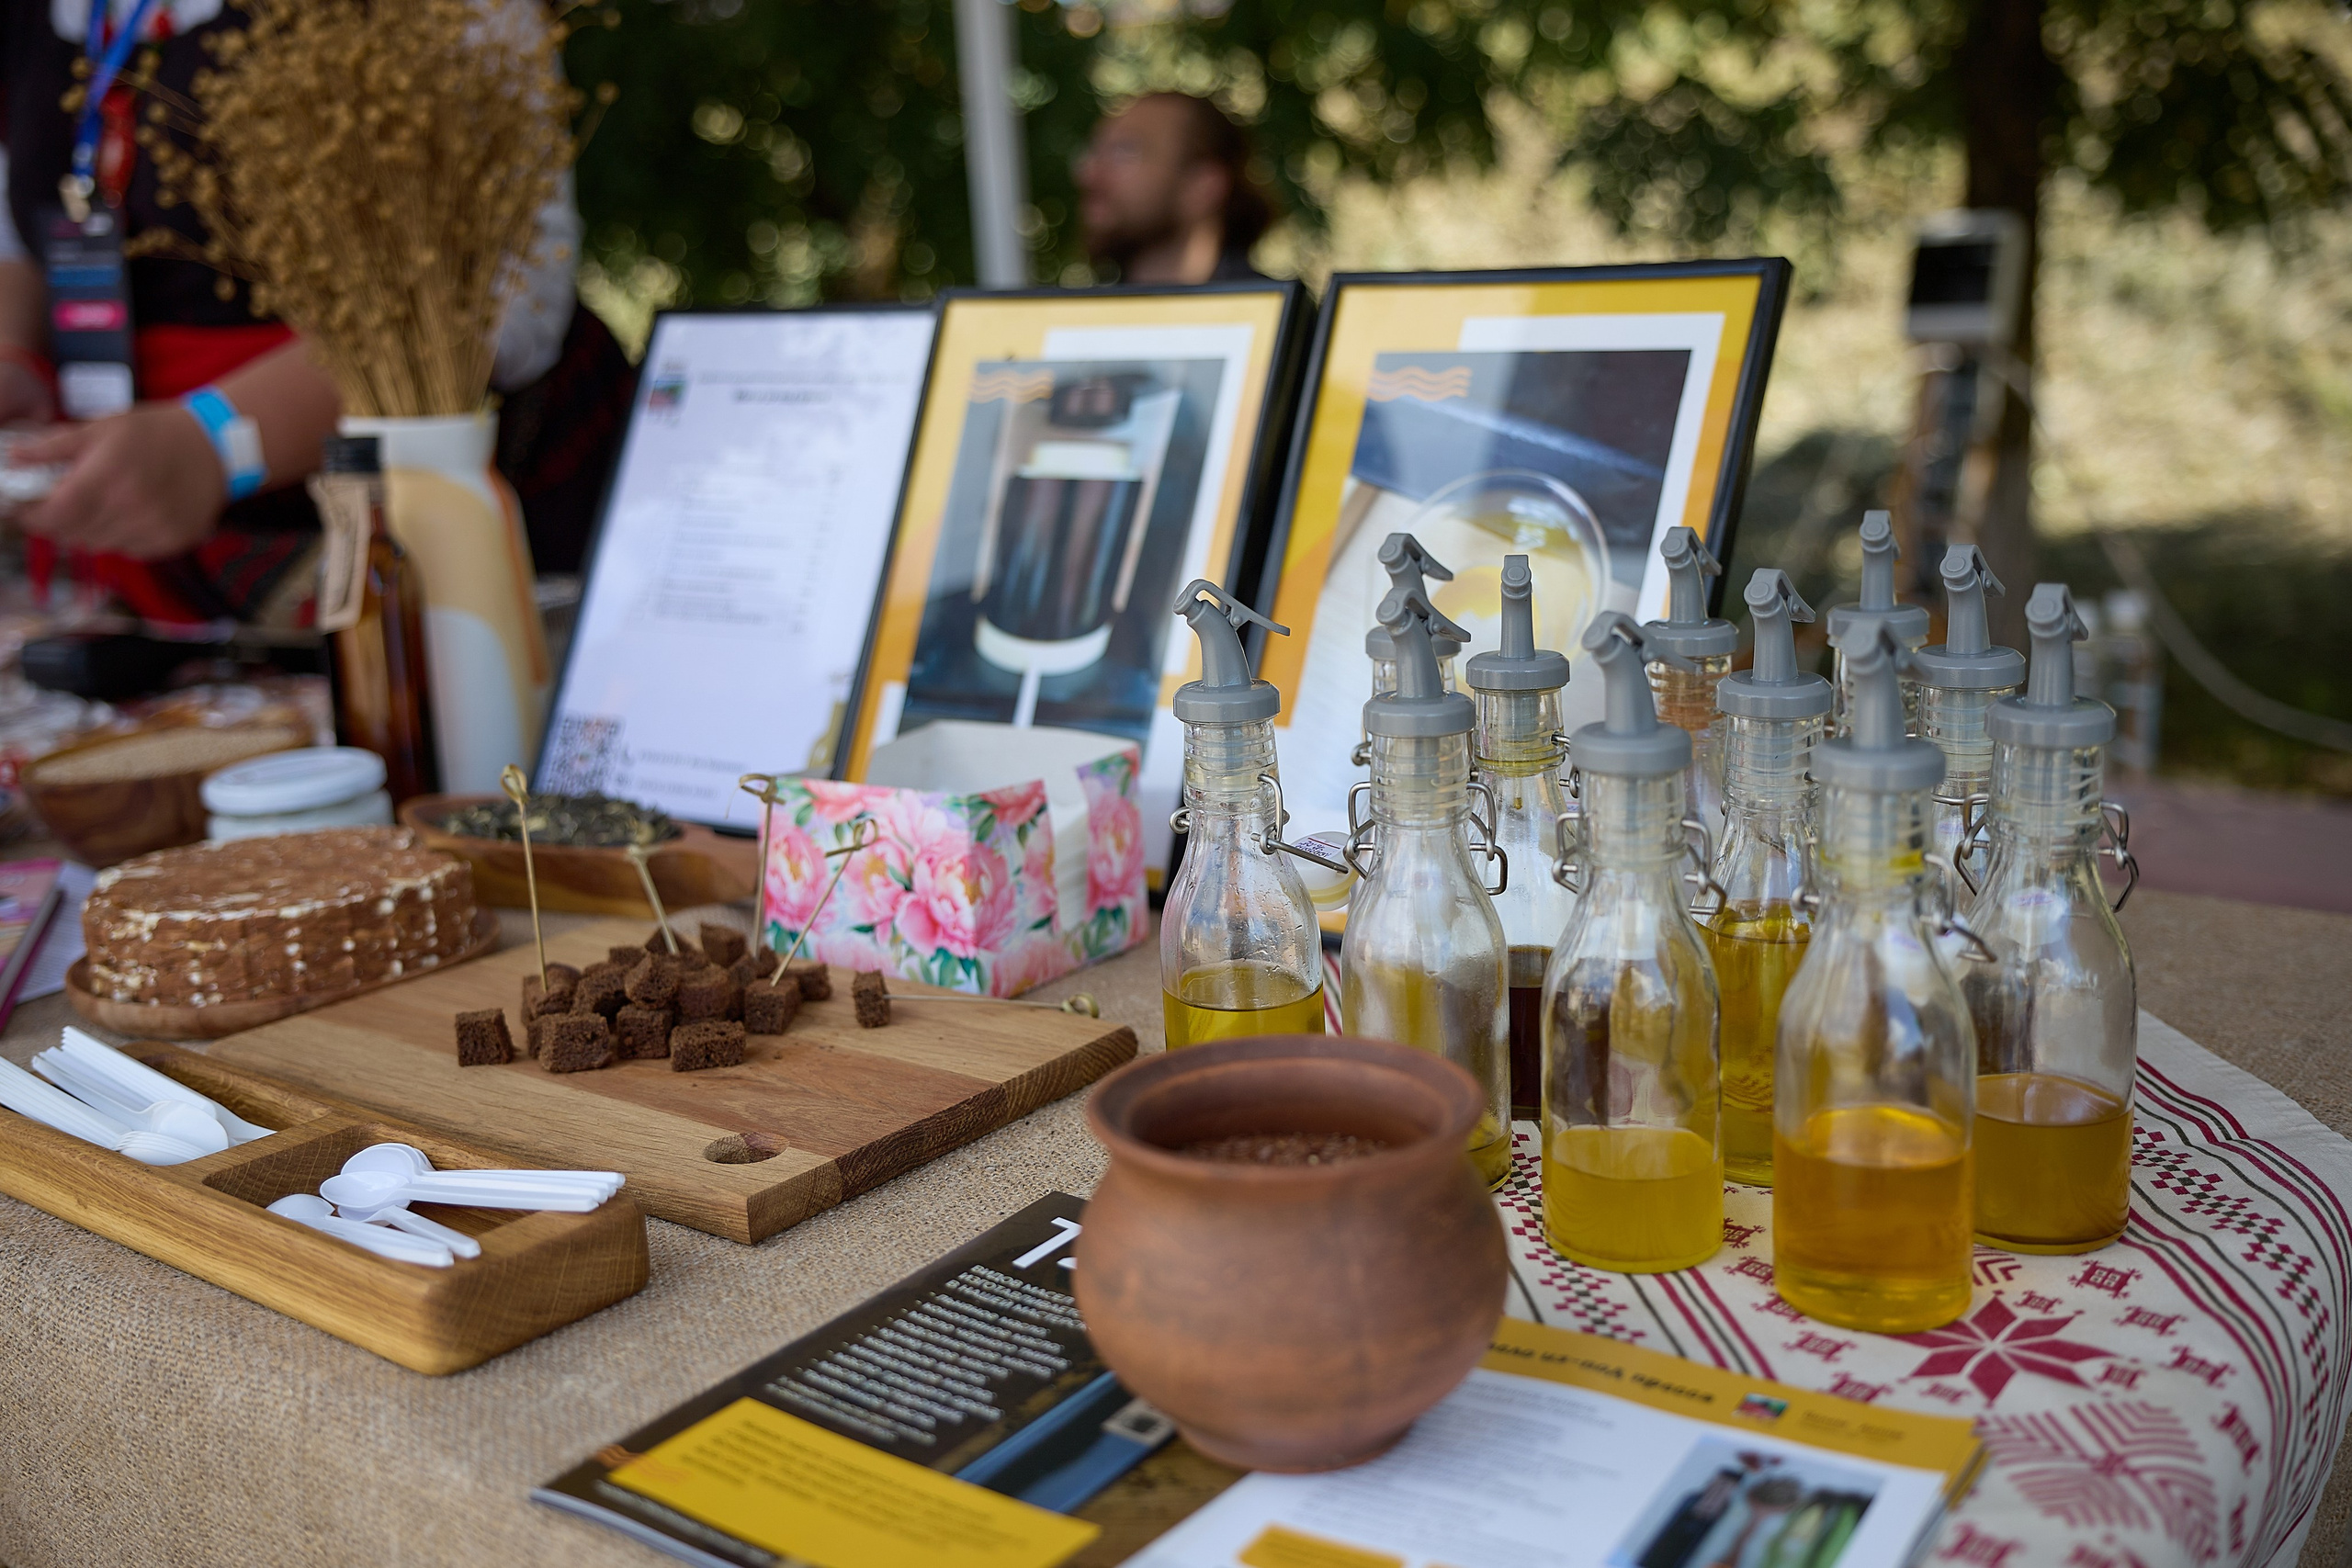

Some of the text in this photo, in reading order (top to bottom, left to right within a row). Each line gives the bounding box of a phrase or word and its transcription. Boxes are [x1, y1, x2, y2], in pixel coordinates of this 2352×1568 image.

[1012, 1216, 1082, 1270] 1
[945, 1279, 960, 1289] В
[957, 1283, 1014, 1308] НАШЕЙ
[970, 1264, 1076, 1304] ВИДОВ МАСЕЛ
[921, 1302, 1011, 1338] конопляное
[935, 1292, 998, 1321] льняное
[891, 1318, 1001, 1361] подсолнечное
